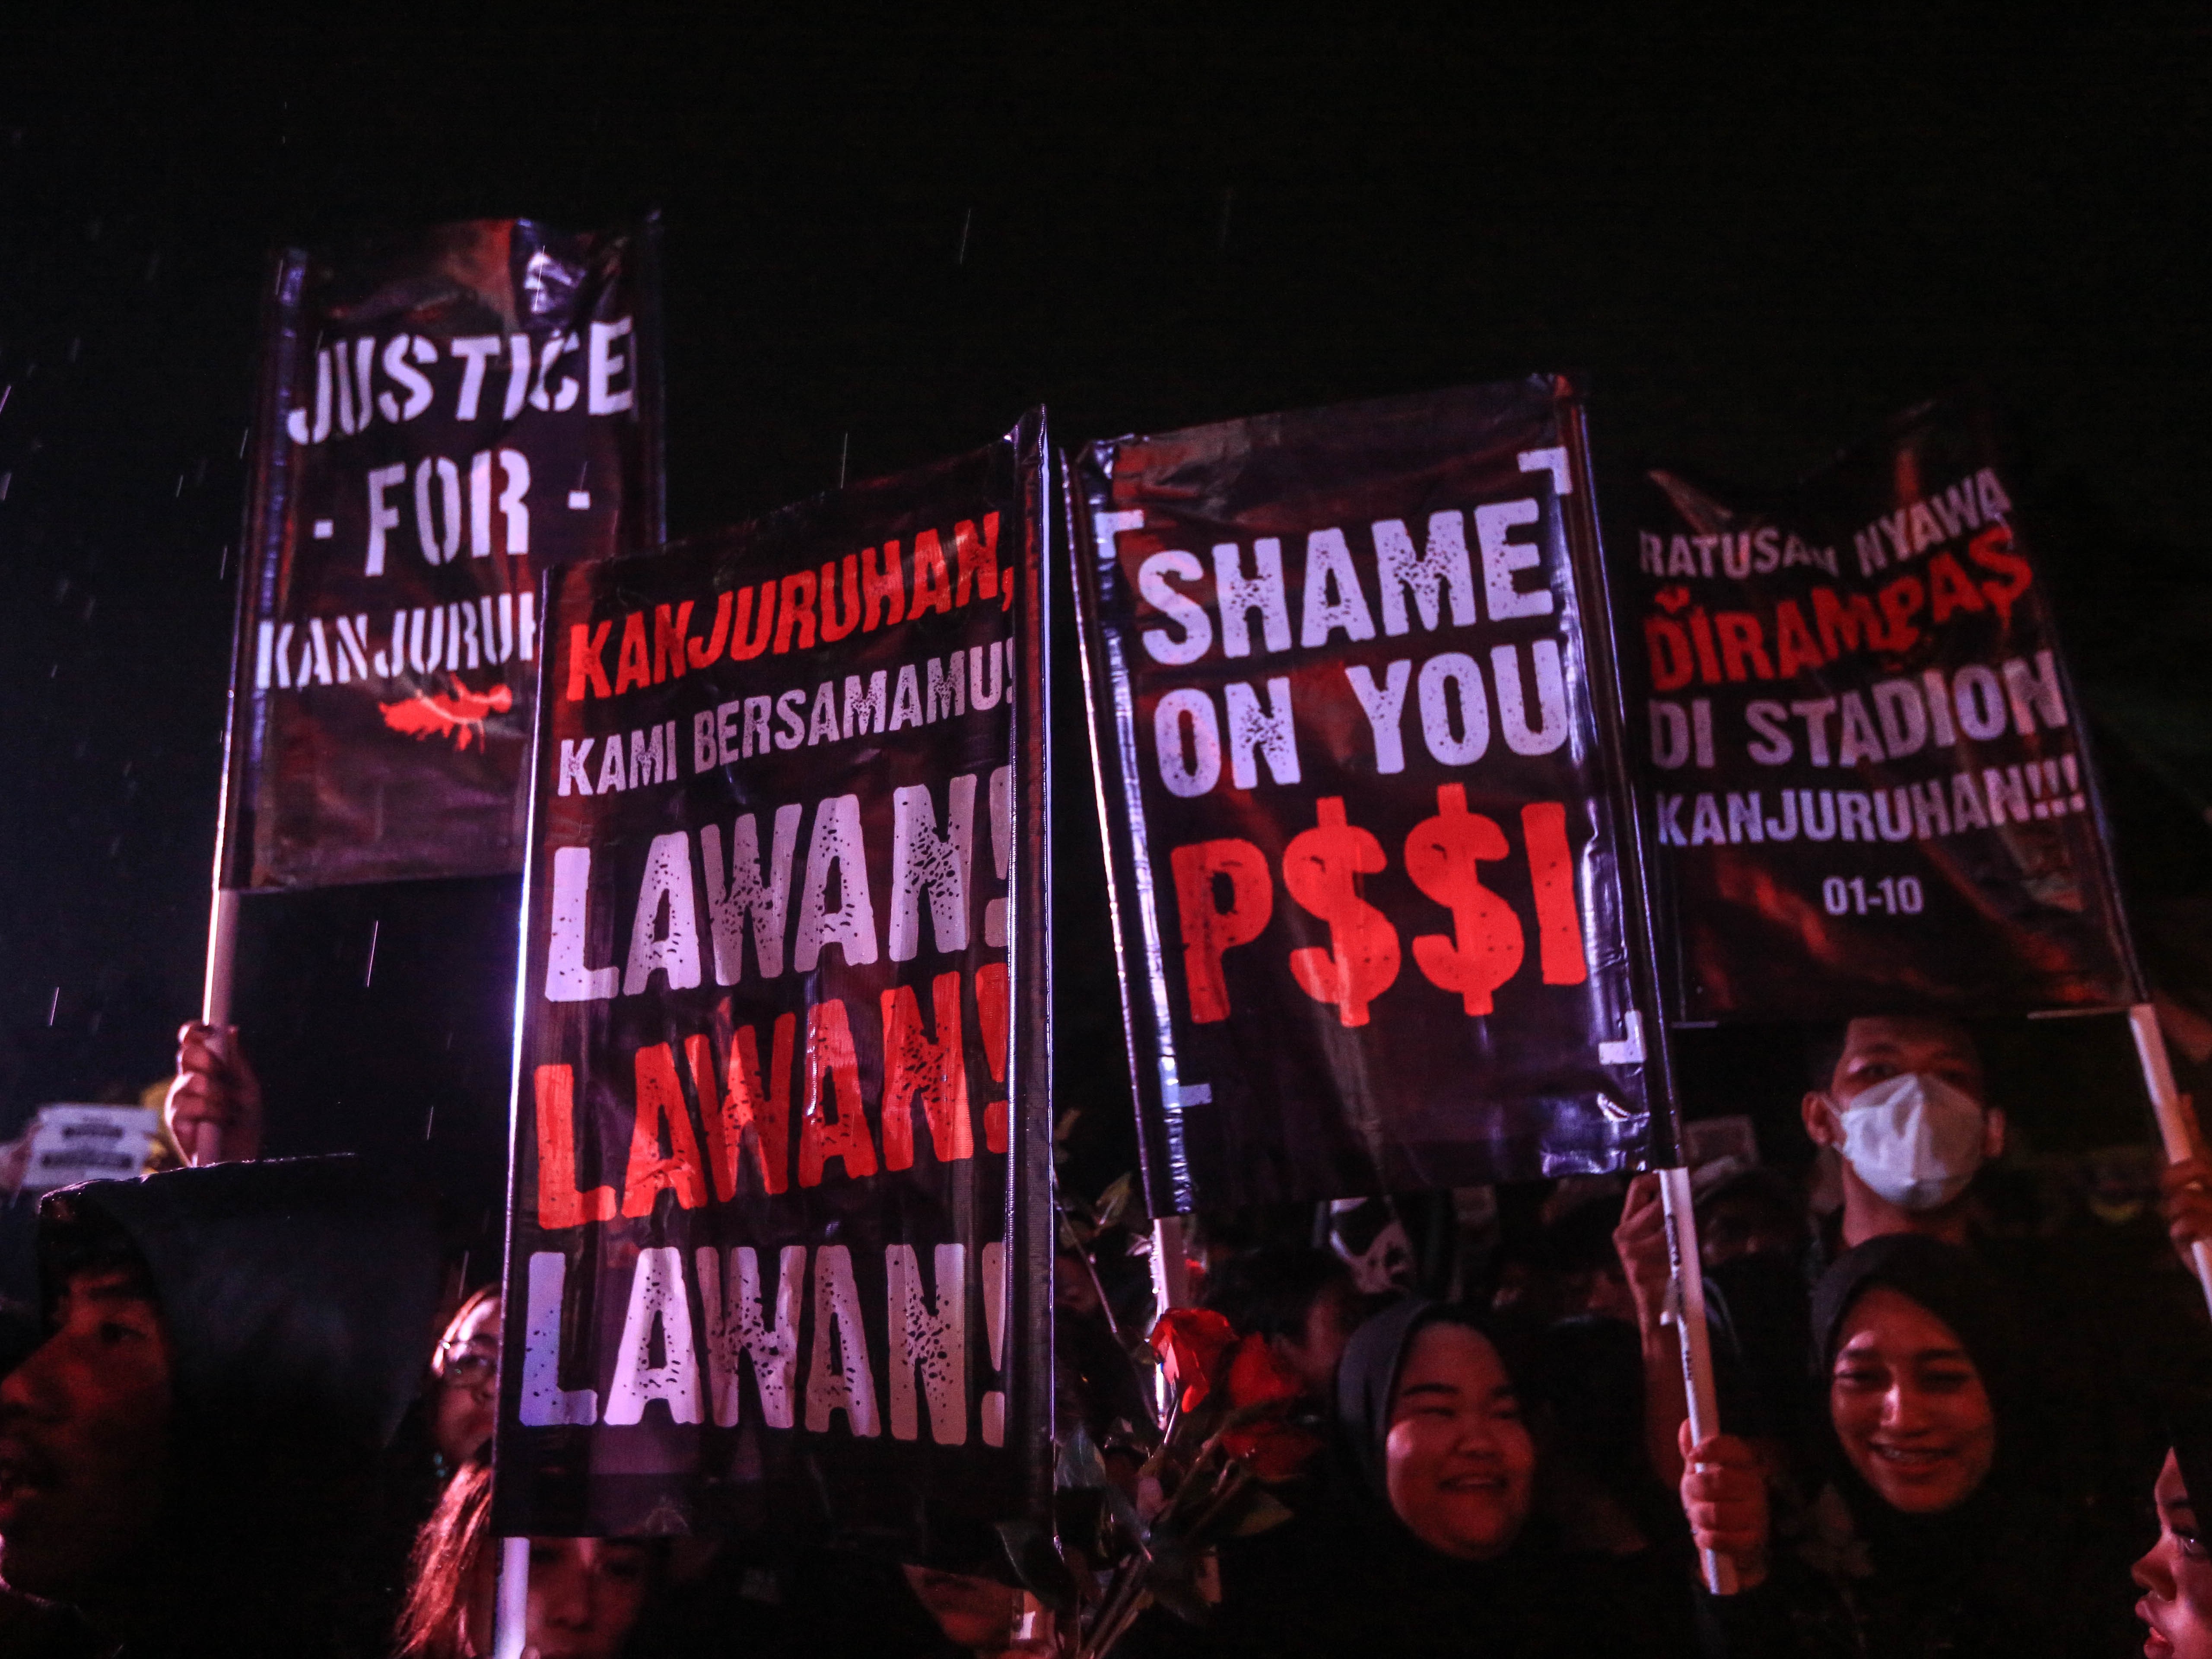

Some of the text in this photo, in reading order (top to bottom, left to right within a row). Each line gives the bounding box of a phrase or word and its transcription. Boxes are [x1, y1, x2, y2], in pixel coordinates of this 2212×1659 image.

[286, 315, 632, 445] JUSTICE
[365, 448, 531, 577] FOR
[1138, 498, 1553, 665] SHAME
[1639, 467, 2012, 581] RATUSAN NYAWA
[567, 512, 1014, 702] KANJURUHAN,
[1643, 524, 2033, 691] DIRAMPAS
[558, 638, 1013, 797] KAMI BERSAMAMU!
[1154, 639, 1568, 797] ON YOU
[1647, 648, 2069, 769] DI STADION
[1656, 753, 2086, 847] KANJURUHAN!!!
[544, 766, 1011, 1002] LAWAN!
[1170, 782, 1587, 1027] P$$I
[1821, 874, 1924, 915] 01-10
[534, 963, 1009, 1230] LAWAN!
[518, 1242, 1006, 1447] LAWAN!
